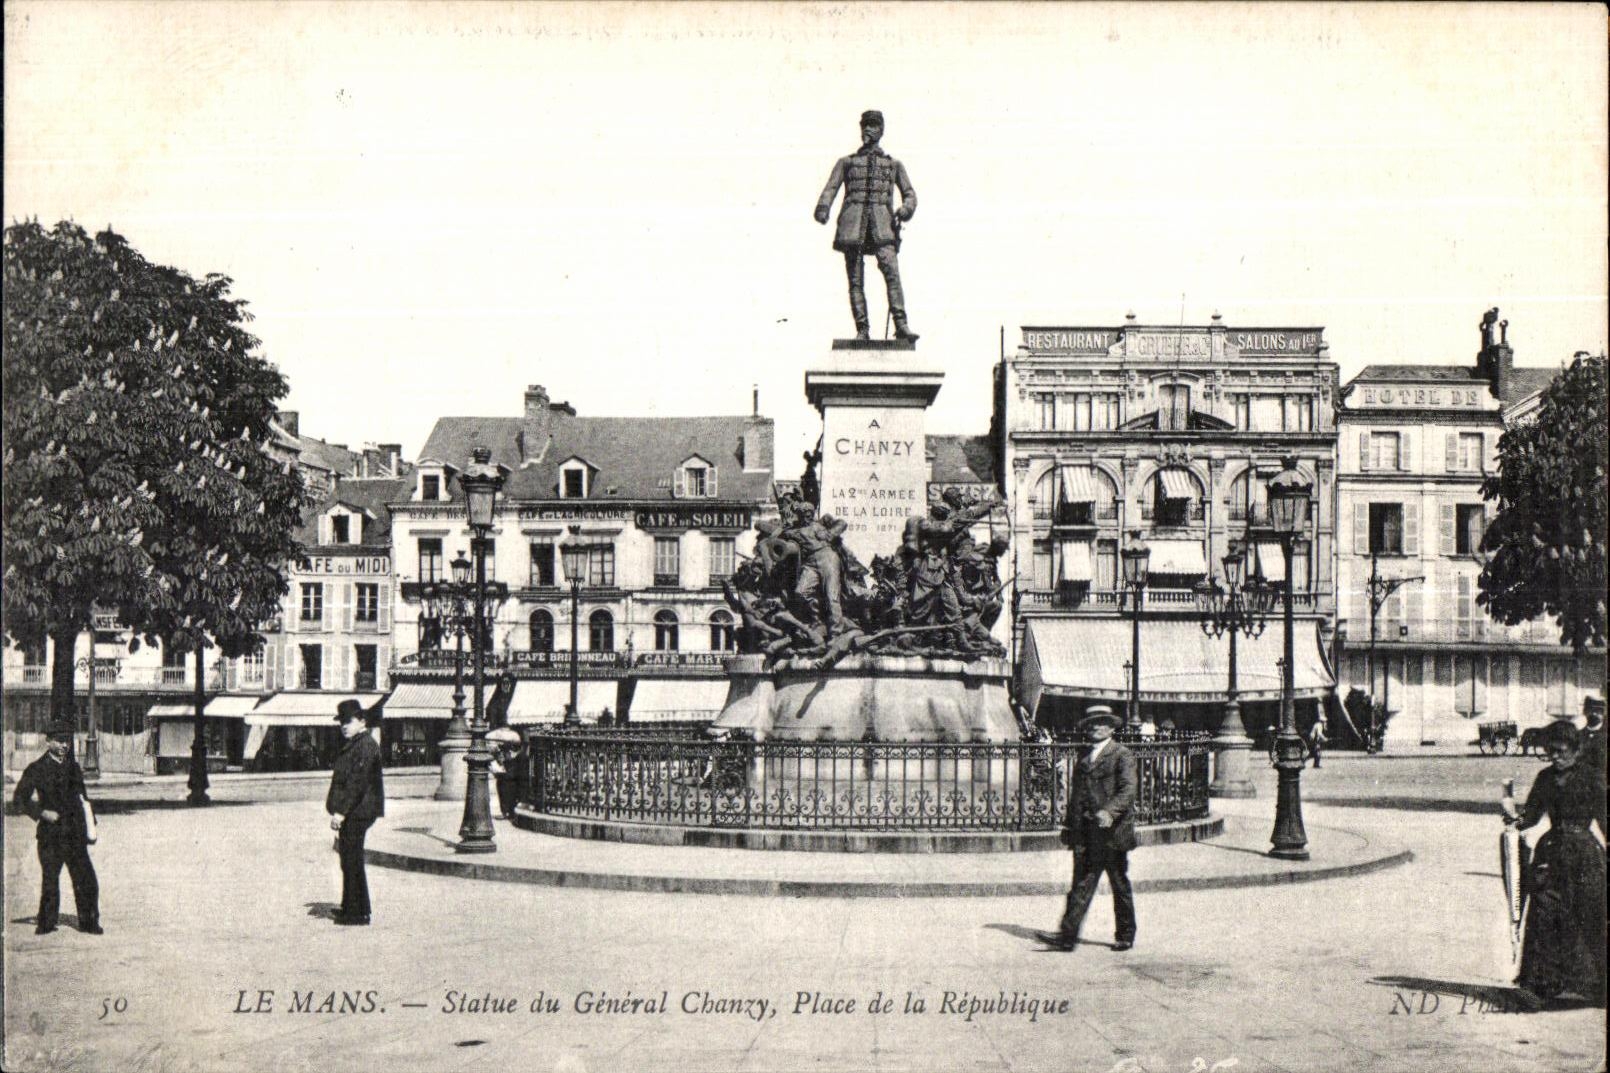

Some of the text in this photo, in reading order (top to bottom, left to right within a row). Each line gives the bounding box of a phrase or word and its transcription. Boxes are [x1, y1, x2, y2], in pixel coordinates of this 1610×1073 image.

[1028, 333, 1109, 349] RESTAURANT
[1238, 333, 1286, 350] SALONS
[1288, 338, 1301, 350] AU
[1364, 389, 1478, 405] HOTEL DE
[868, 418, 881, 429] A
[835, 438, 914, 456] CHANZY
[868, 472, 879, 482] A
[832, 488, 845, 499] LA
[835, 506, 912, 517] DE LA LOIRE
[636, 512, 677, 527] CAFE
[692, 512, 749, 527] SOLEIL
[338, 564, 351, 574] DU
[355, 558, 386, 573] MIDI
[517, 652, 546, 662] CAFE
[645, 654, 679, 665] CAFE
